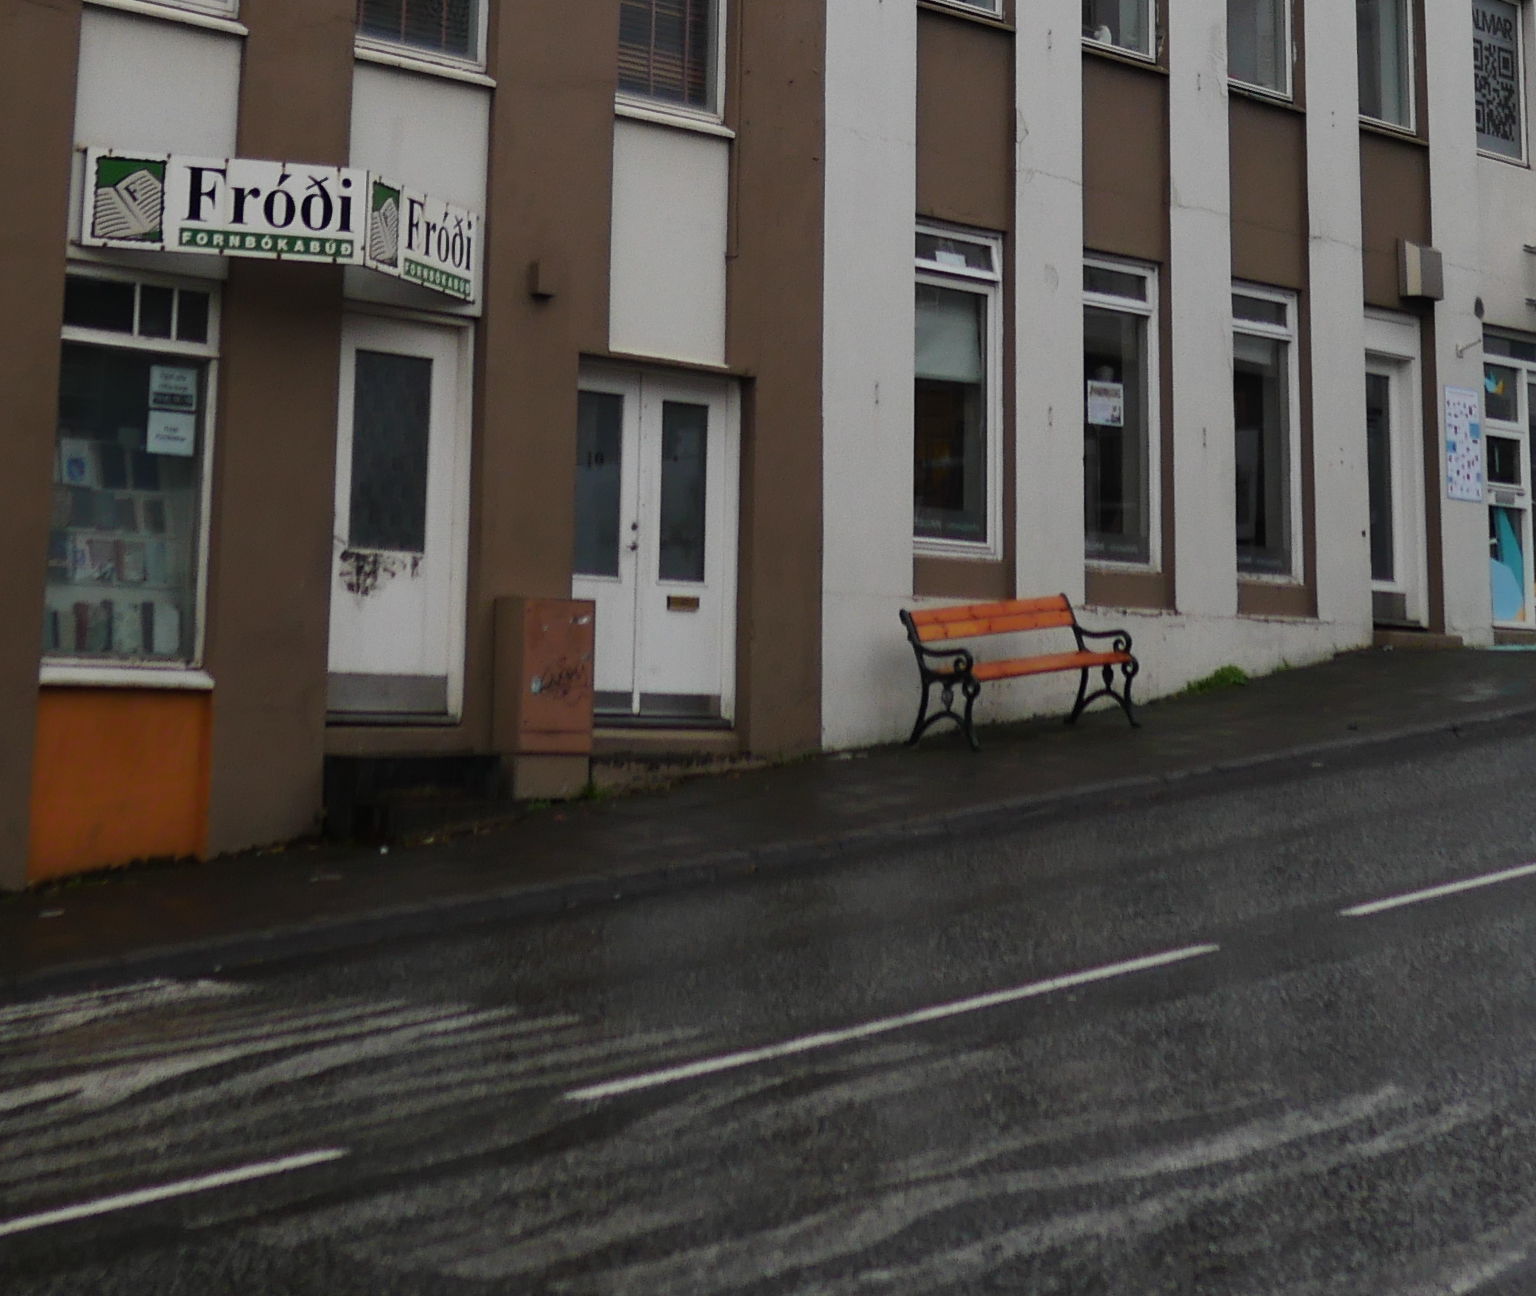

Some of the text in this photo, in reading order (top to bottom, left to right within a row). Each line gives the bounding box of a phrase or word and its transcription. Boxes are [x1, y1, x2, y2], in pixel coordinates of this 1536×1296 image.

[183, 165, 355, 234] Fróði
[406, 197, 472, 271] Fróði
[181, 232, 352, 256] FORNBÓKABÚÐ
